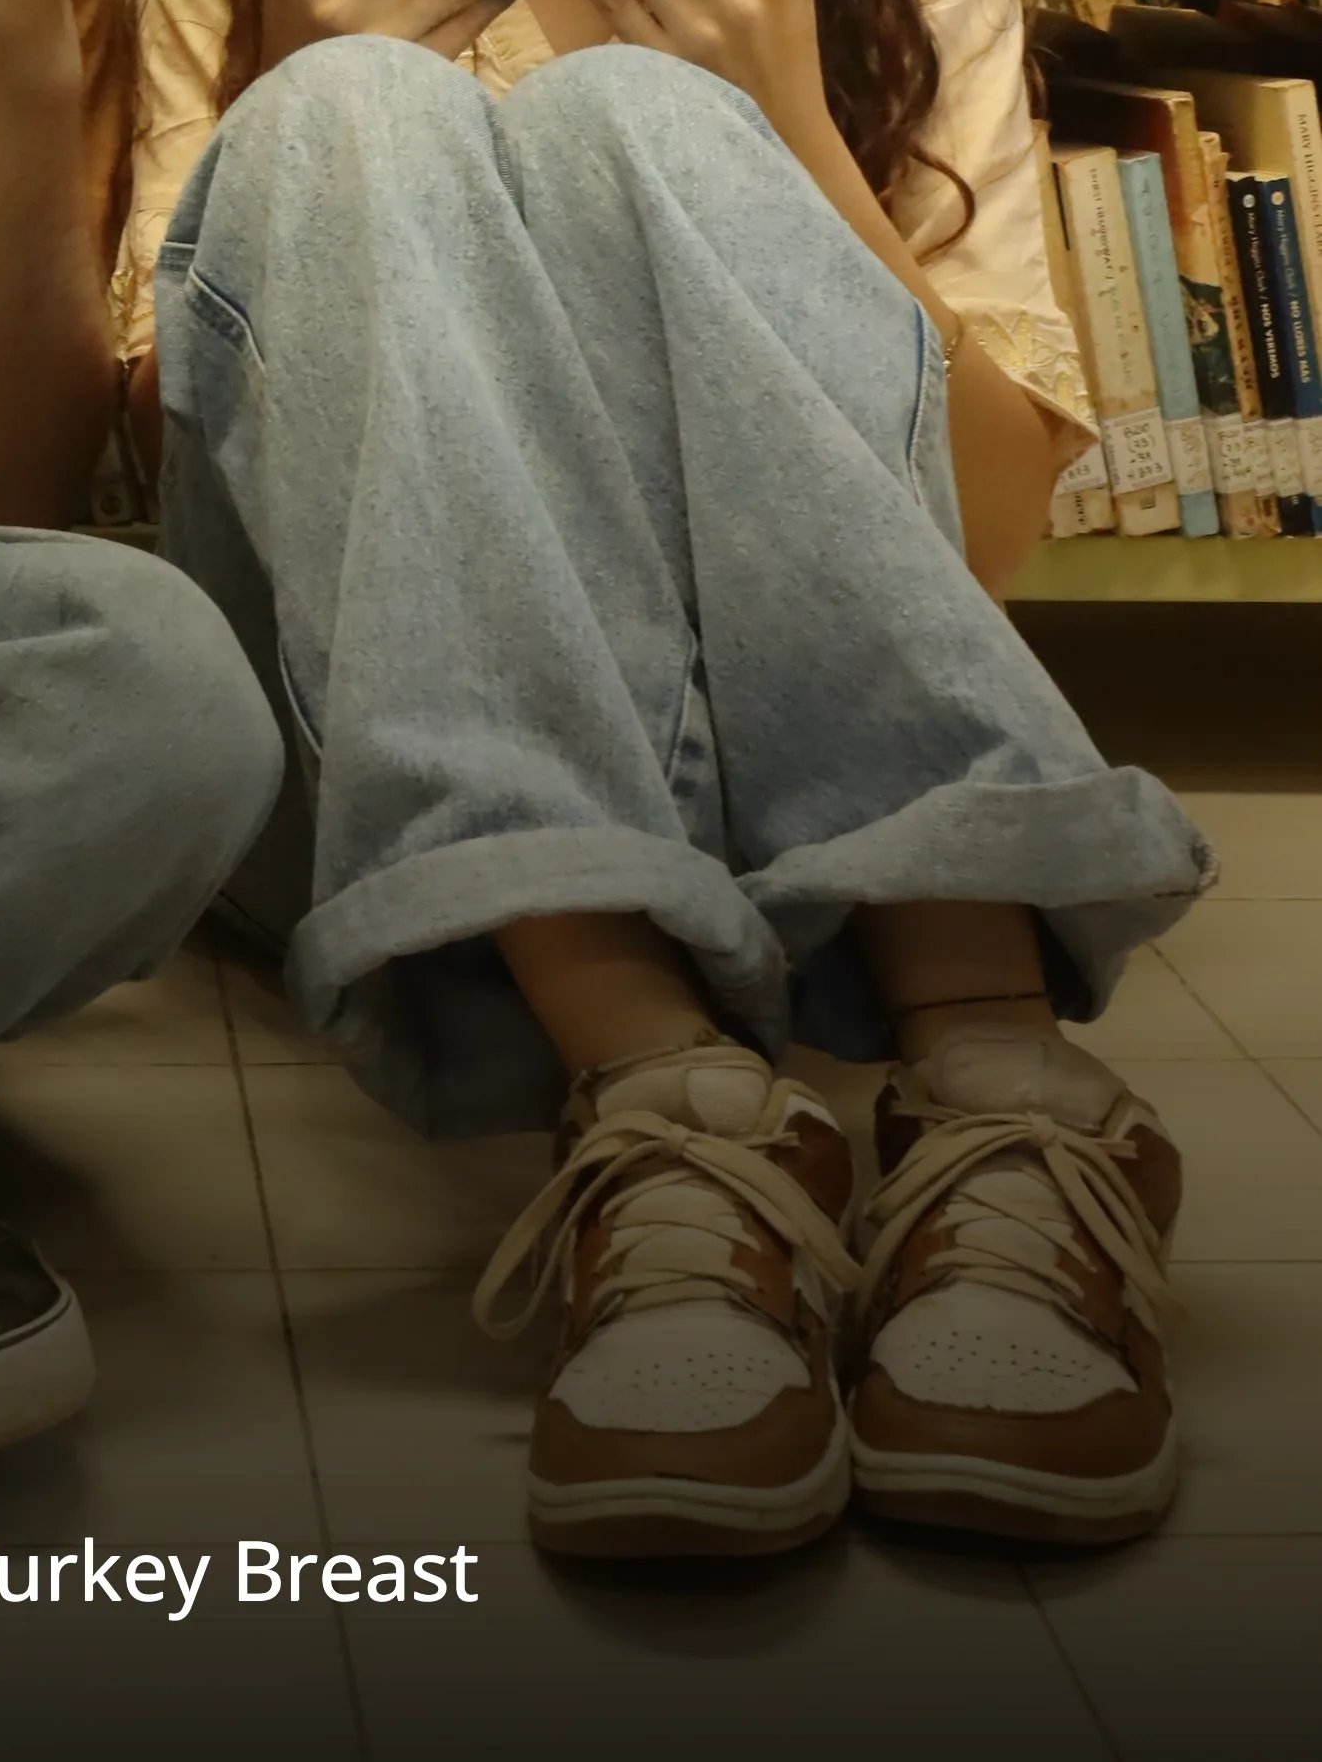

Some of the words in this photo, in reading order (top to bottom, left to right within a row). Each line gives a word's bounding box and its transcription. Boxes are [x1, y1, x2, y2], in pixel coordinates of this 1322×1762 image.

[1297, 112, 1311, 150] MARY
[1260, 302, 1272, 328] NOS
[1288, 299, 1301, 318] NO
[1264, 328, 1280, 380] VEREMOS
[1292, 318, 1309, 359] LLORES
